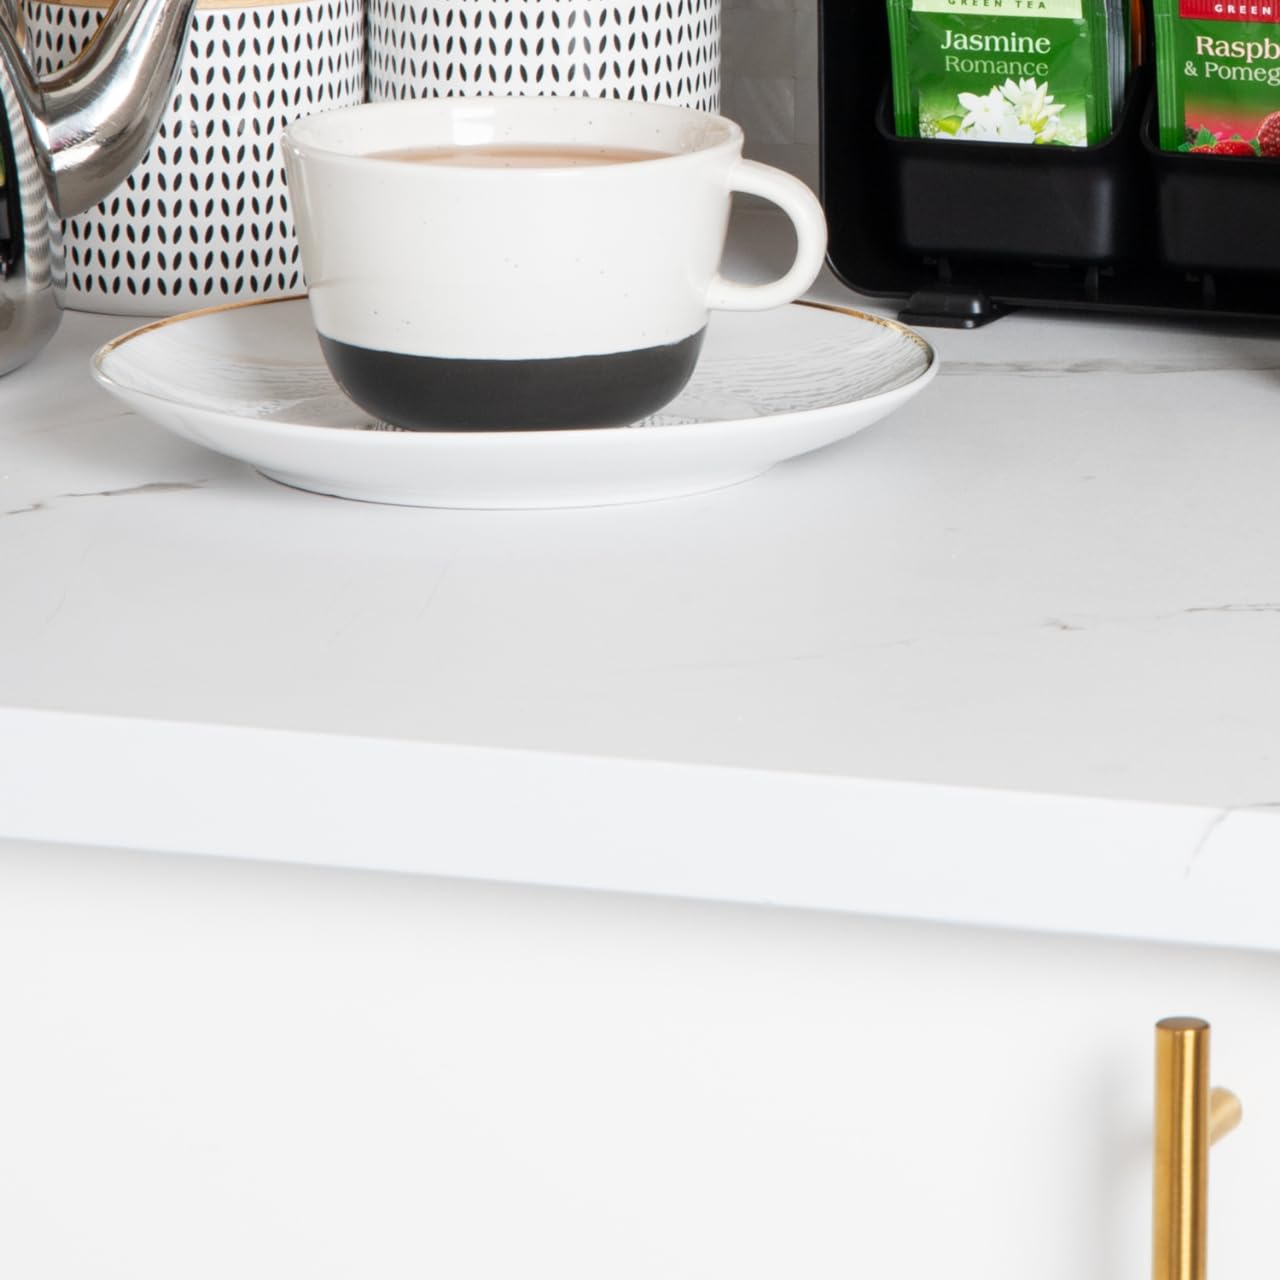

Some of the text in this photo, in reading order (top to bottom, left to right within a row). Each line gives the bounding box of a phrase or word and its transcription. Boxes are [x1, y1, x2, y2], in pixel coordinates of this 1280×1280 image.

[1015, 0, 1047, 9] TEA
[1214, 4, 1272, 16] GREEN
[940, 30, 1051, 54] Jasmine
[944, 55, 1049, 76] Romance
[1184, 61, 1198, 77] &
